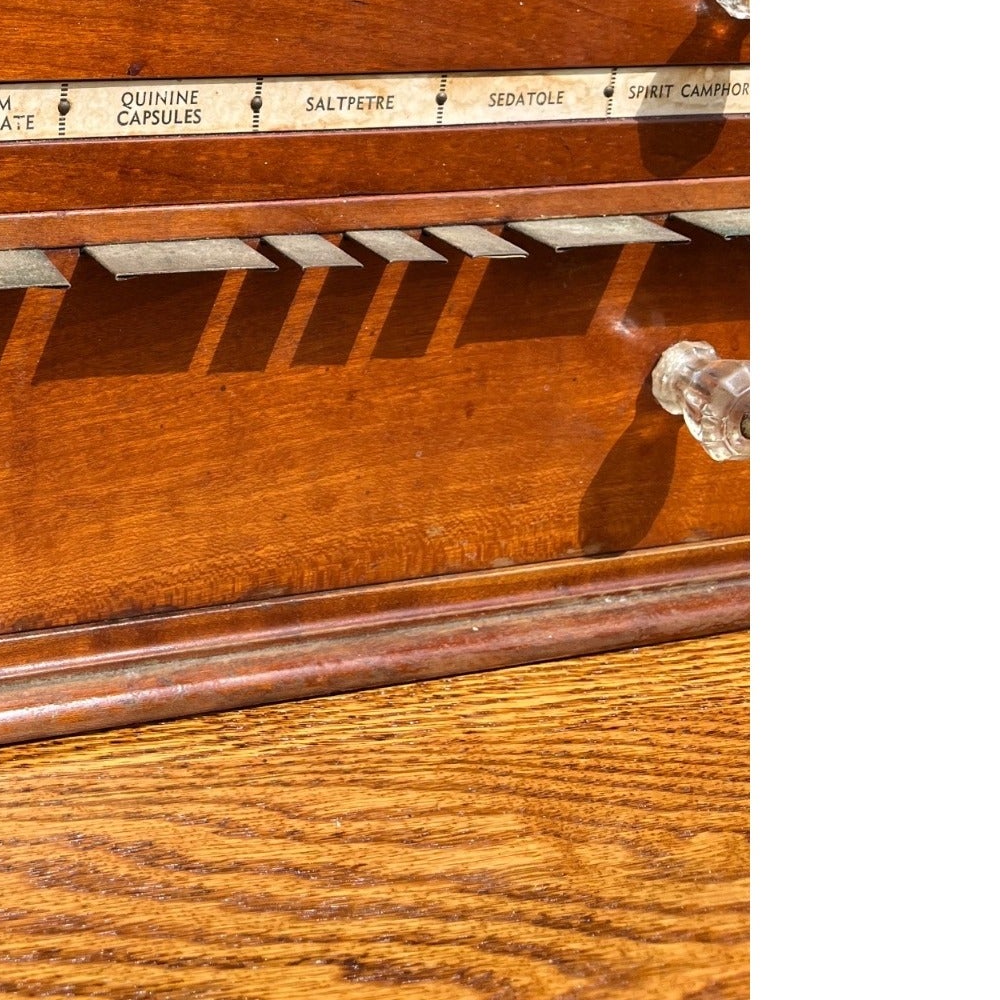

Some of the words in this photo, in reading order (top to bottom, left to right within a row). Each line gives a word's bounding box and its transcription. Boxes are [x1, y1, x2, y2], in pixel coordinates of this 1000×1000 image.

[120, 90, 199, 107] QUININE
[488, 90, 564, 107] SEDATOLE
[628, 84, 674, 99] SPIRIT
[681, 82, 750, 98] CAMPHOR
[305, 95, 395, 112] SALTPETRE
[116, 108, 202, 127] CAPSULES
